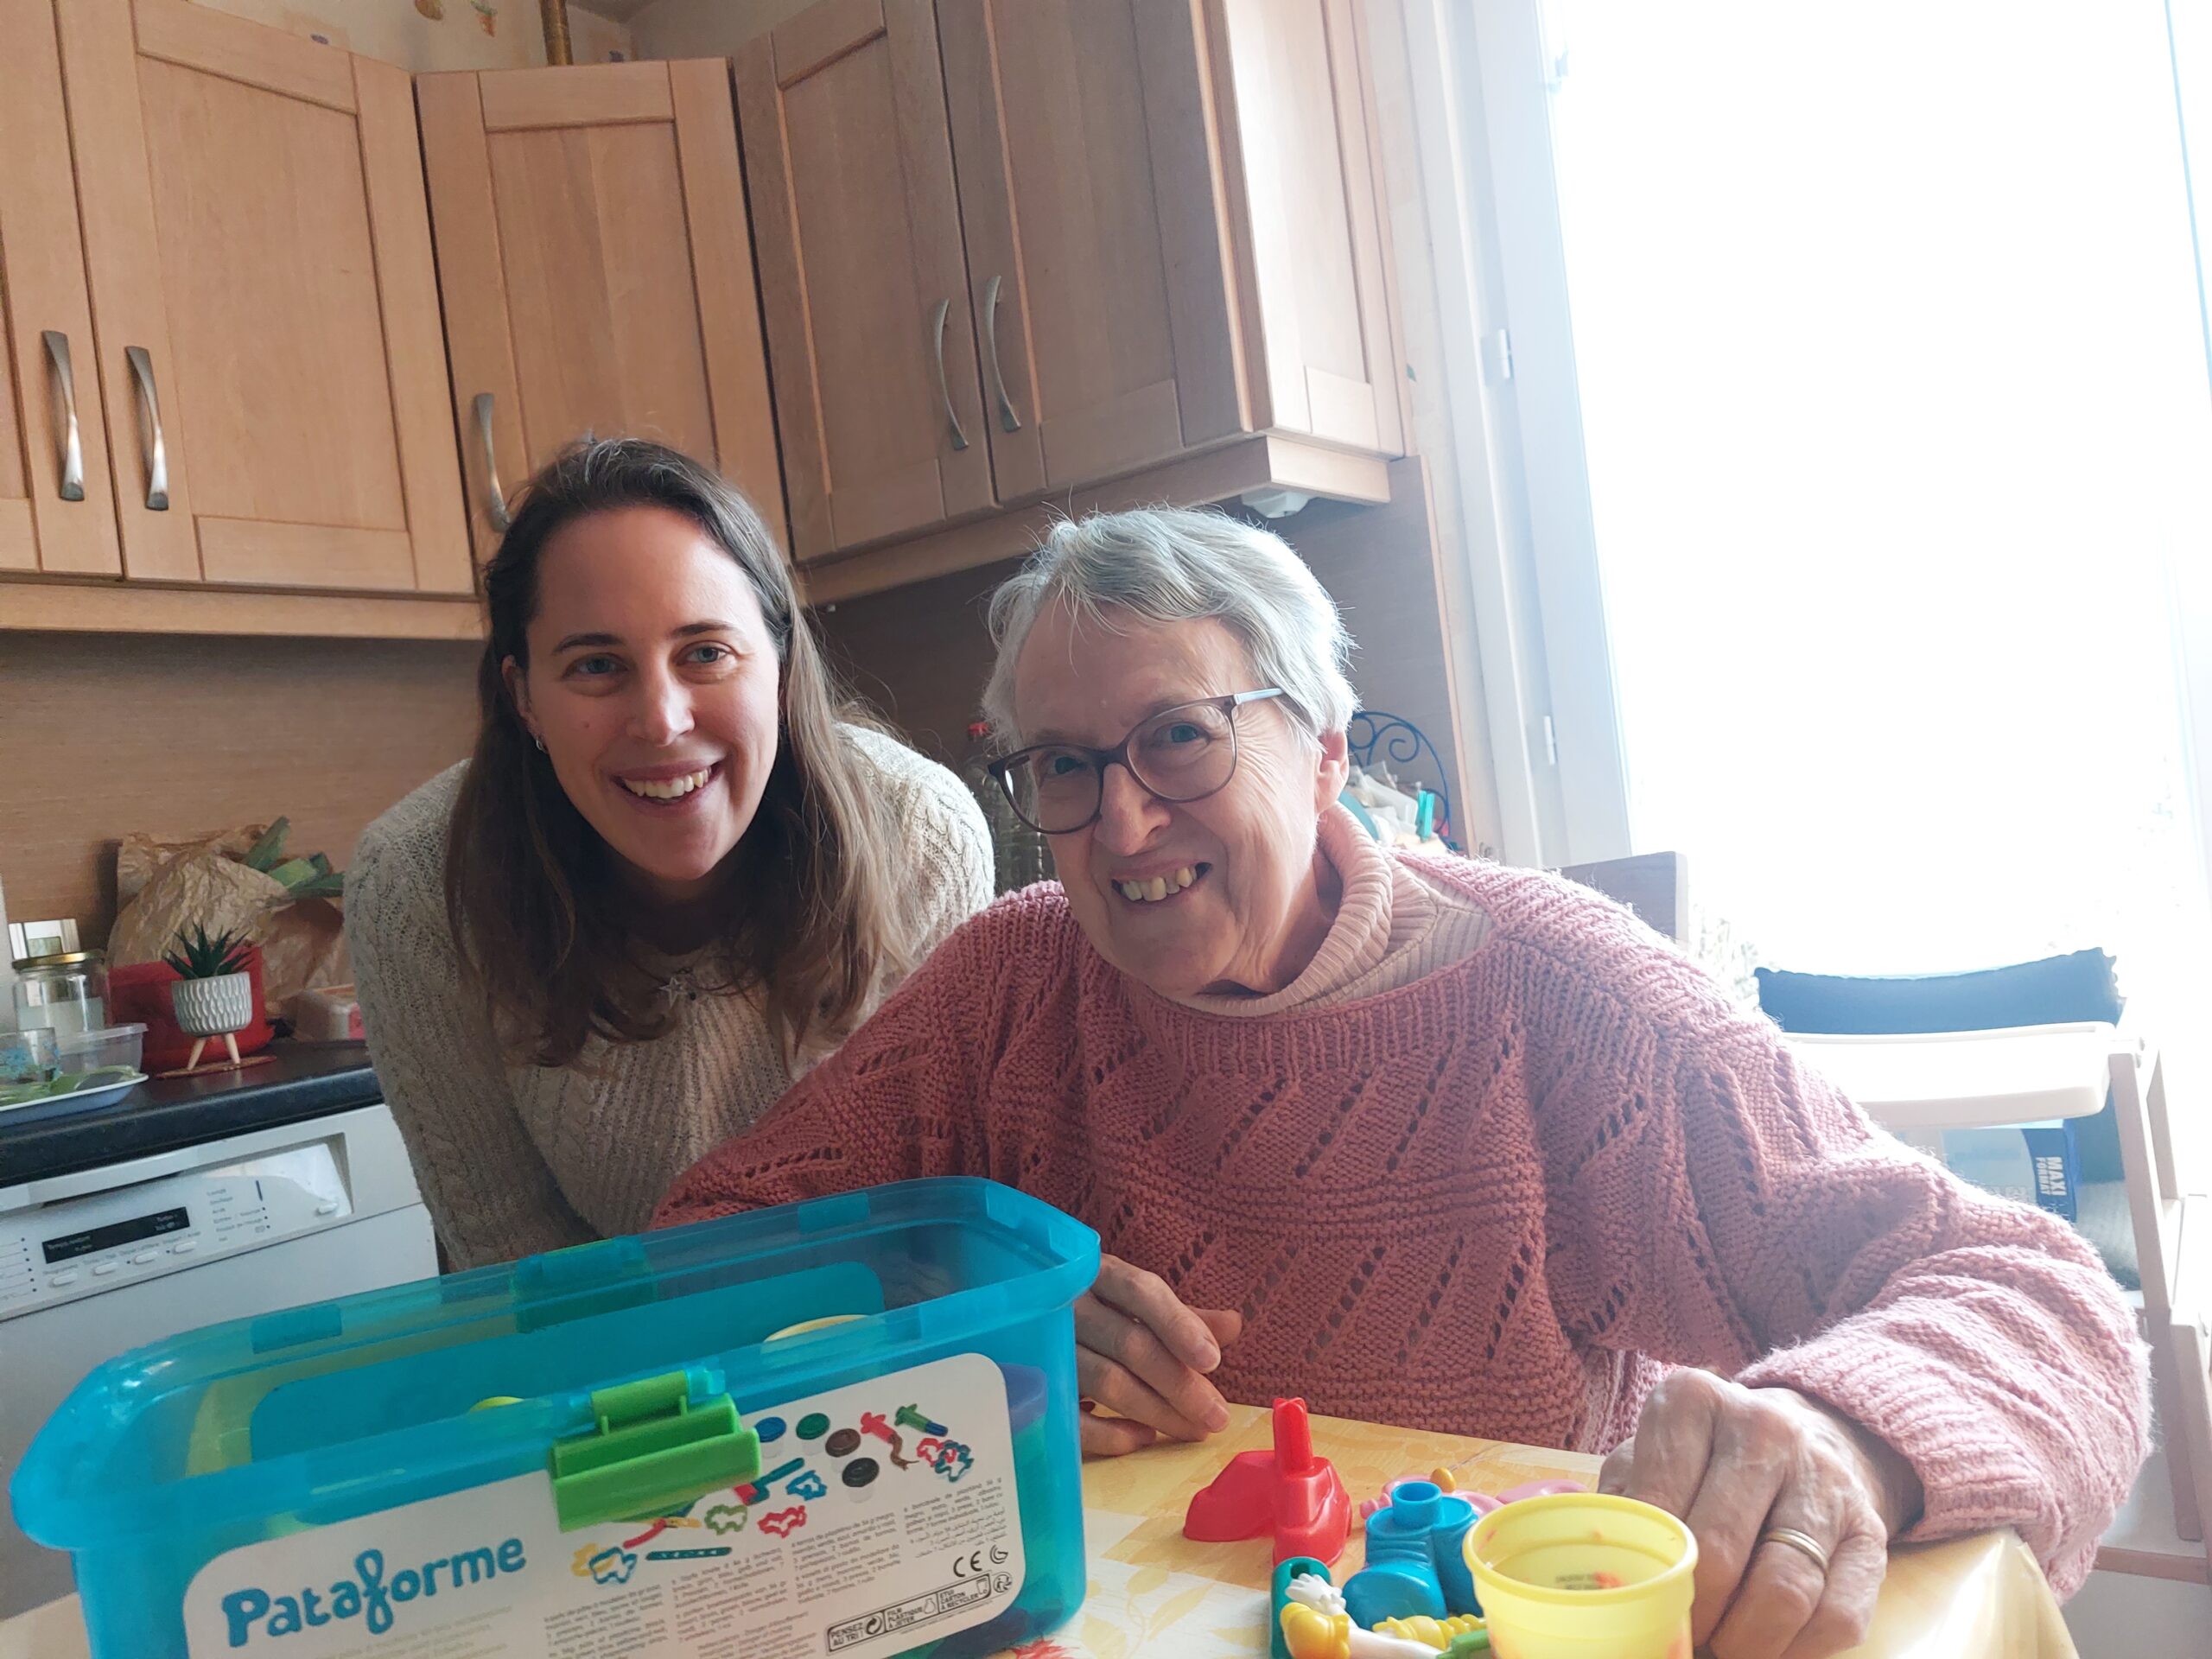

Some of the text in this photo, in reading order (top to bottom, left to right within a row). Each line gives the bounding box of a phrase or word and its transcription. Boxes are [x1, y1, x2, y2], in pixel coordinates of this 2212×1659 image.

[2035, 1156, 2051, 1196] FORMAT
[2045, 1155, 2068, 1196] MAXI
[953, 1551, 983, 1578] CE
[221, 1538, 527, 1649] Pataforme
[940, 1591, 966, 1605] CARTON
[947, 1592, 979, 1609] RECYCLER
[887, 1605, 924, 1624] PLASTIQUE
[830, 1623, 865, 1638] PENSEZ
[832, 1636, 844, 1647] AU
